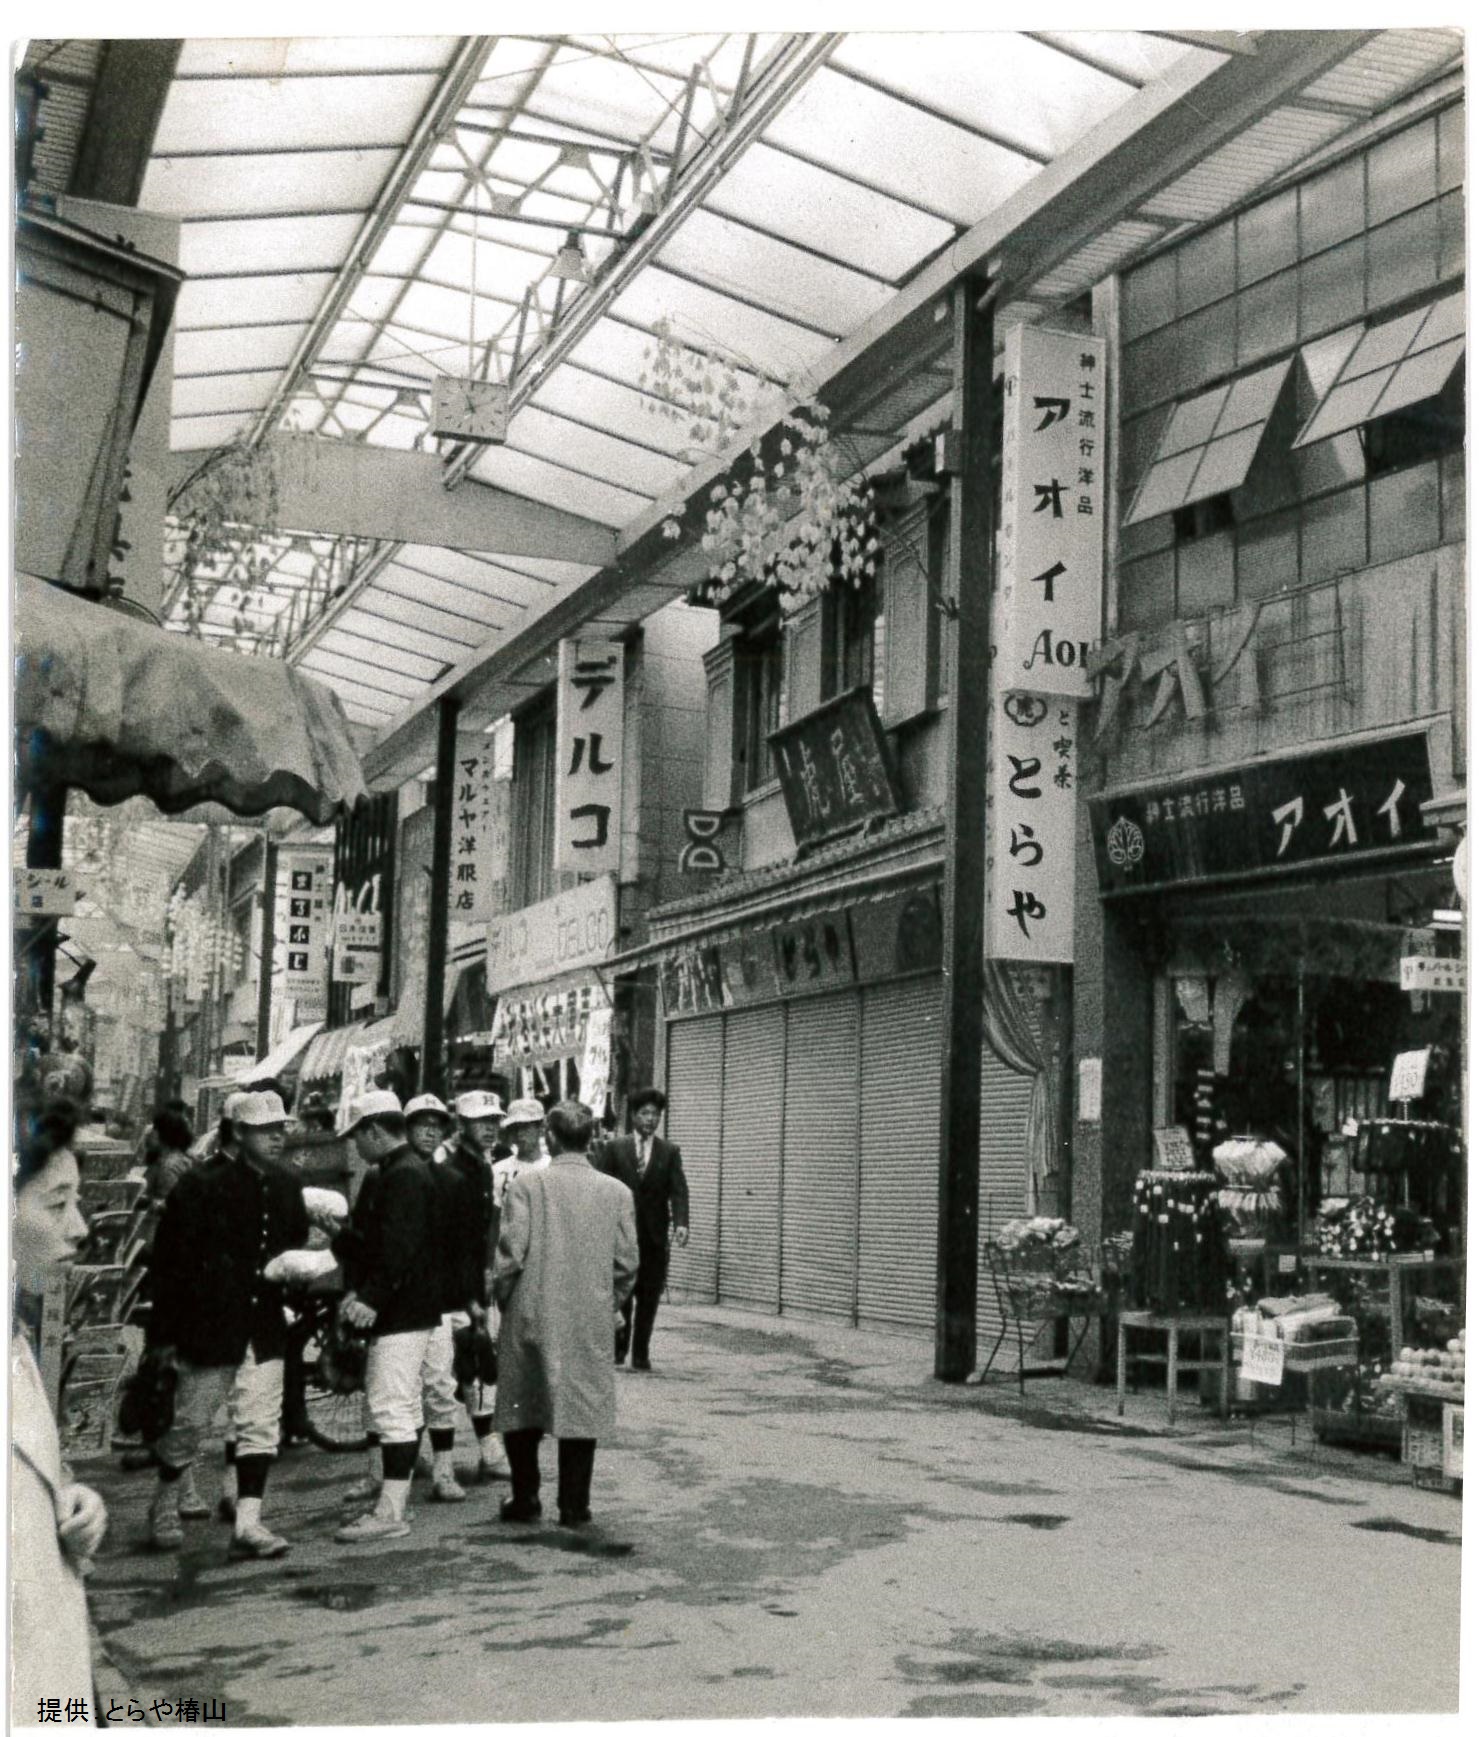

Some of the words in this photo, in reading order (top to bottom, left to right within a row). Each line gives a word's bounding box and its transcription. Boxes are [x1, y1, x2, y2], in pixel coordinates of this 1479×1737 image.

[1030, 396, 1071, 602] アオイ
[567, 654, 617, 849] デルコ
[1052, 709, 1072, 789] と喫茶
[1270, 777, 1406, 857] アオイ
[455, 757, 480, 911] マルヤ洋服店
[1006, 754, 1047, 940] とらや
[482, 1095, 495, 1106] H
